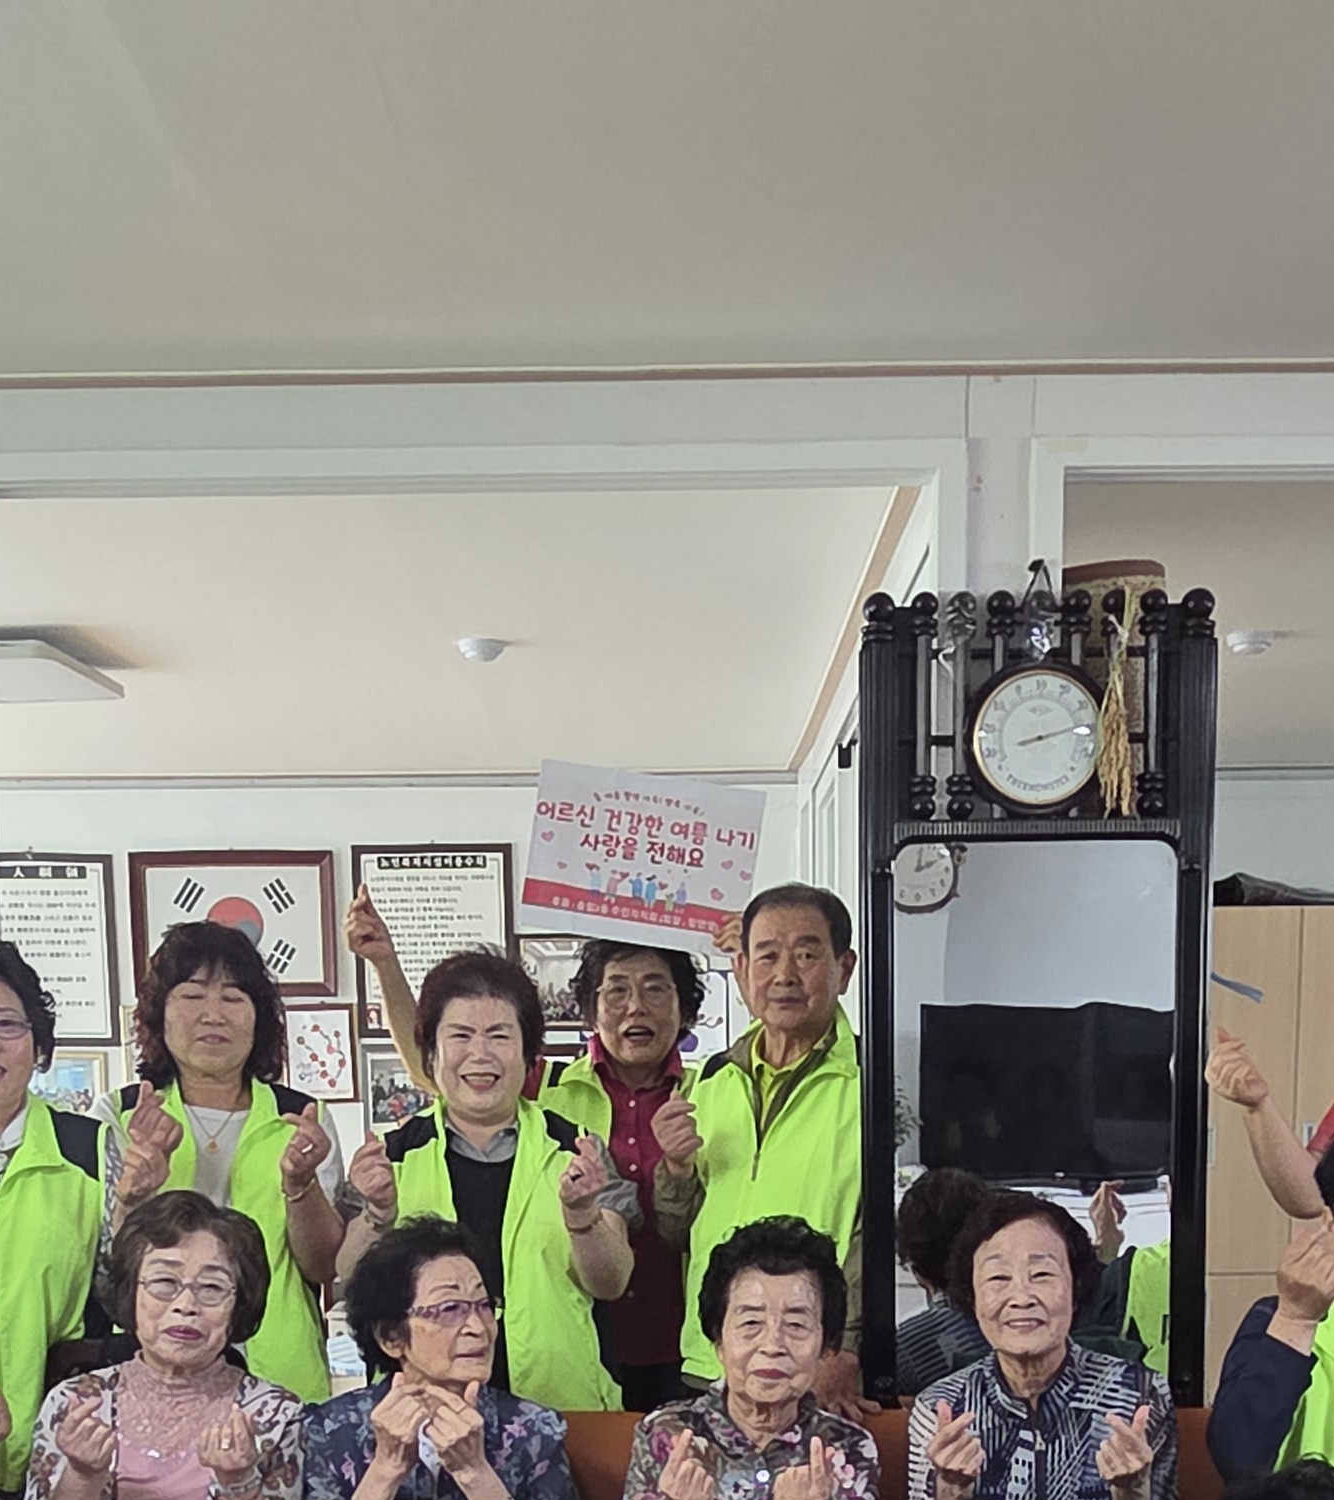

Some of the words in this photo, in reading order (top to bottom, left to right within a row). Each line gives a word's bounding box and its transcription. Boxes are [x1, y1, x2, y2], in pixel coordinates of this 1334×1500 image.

[536, 801, 595, 828] 어르신
[604, 808, 664, 839] 건강한
[670, 821, 708, 846] 여름
[716, 828, 755, 850] 나기
[579, 833, 639, 861] 사랑을
[645, 840, 705, 868] 전해요
